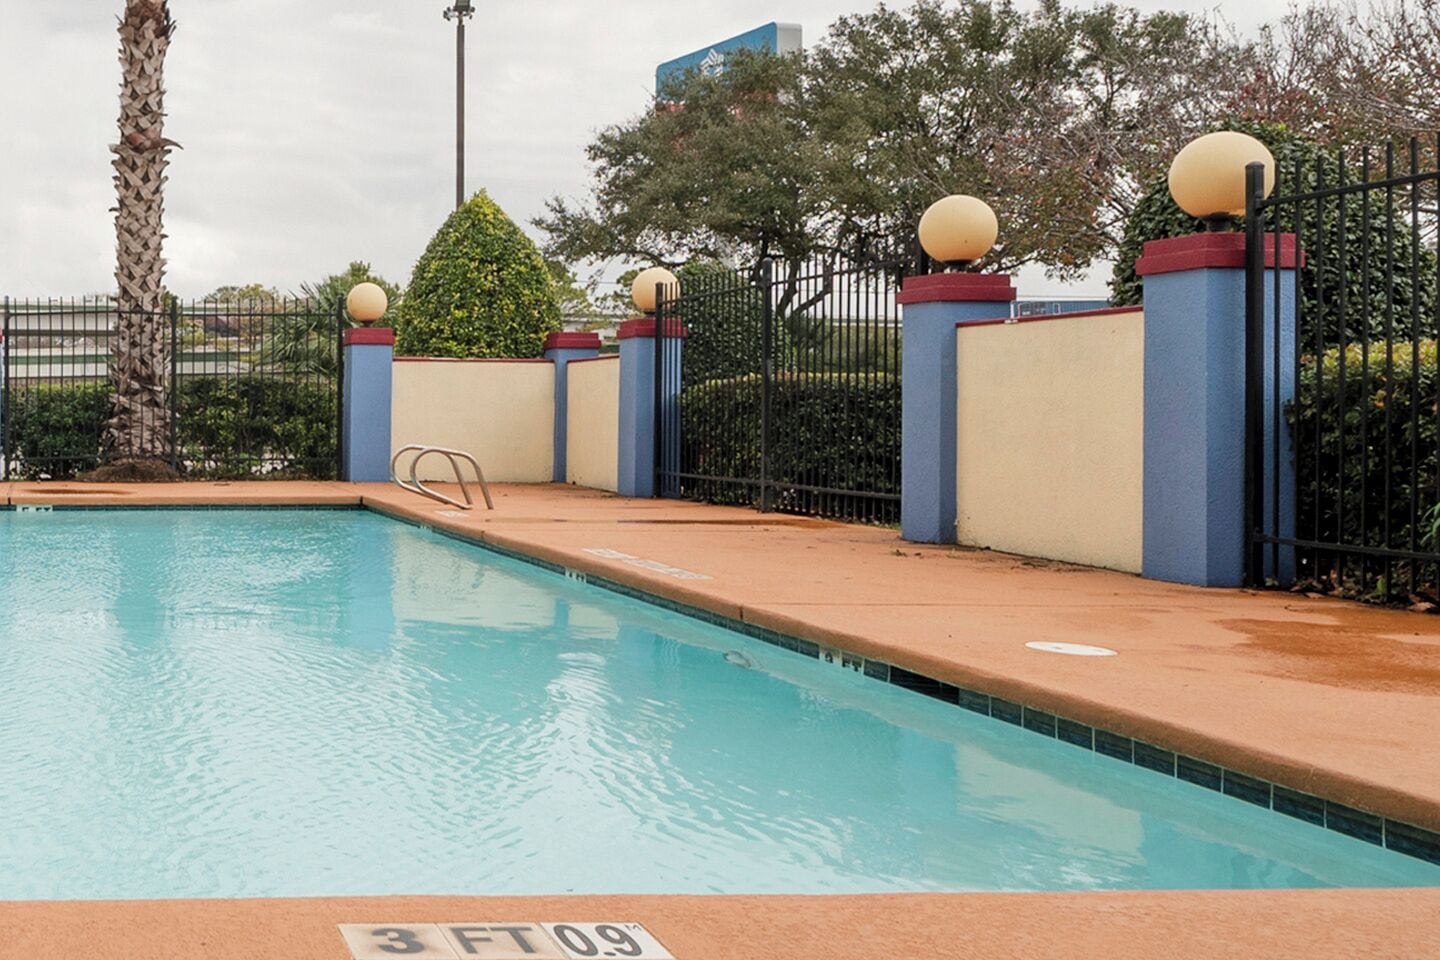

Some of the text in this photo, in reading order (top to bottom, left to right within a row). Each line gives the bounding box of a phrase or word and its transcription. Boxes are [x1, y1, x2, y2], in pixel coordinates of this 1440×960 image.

[371, 928, 425, 955] 3
[450, 926, 538, 954] FT
[553, 925, 642, 957] 0.9
